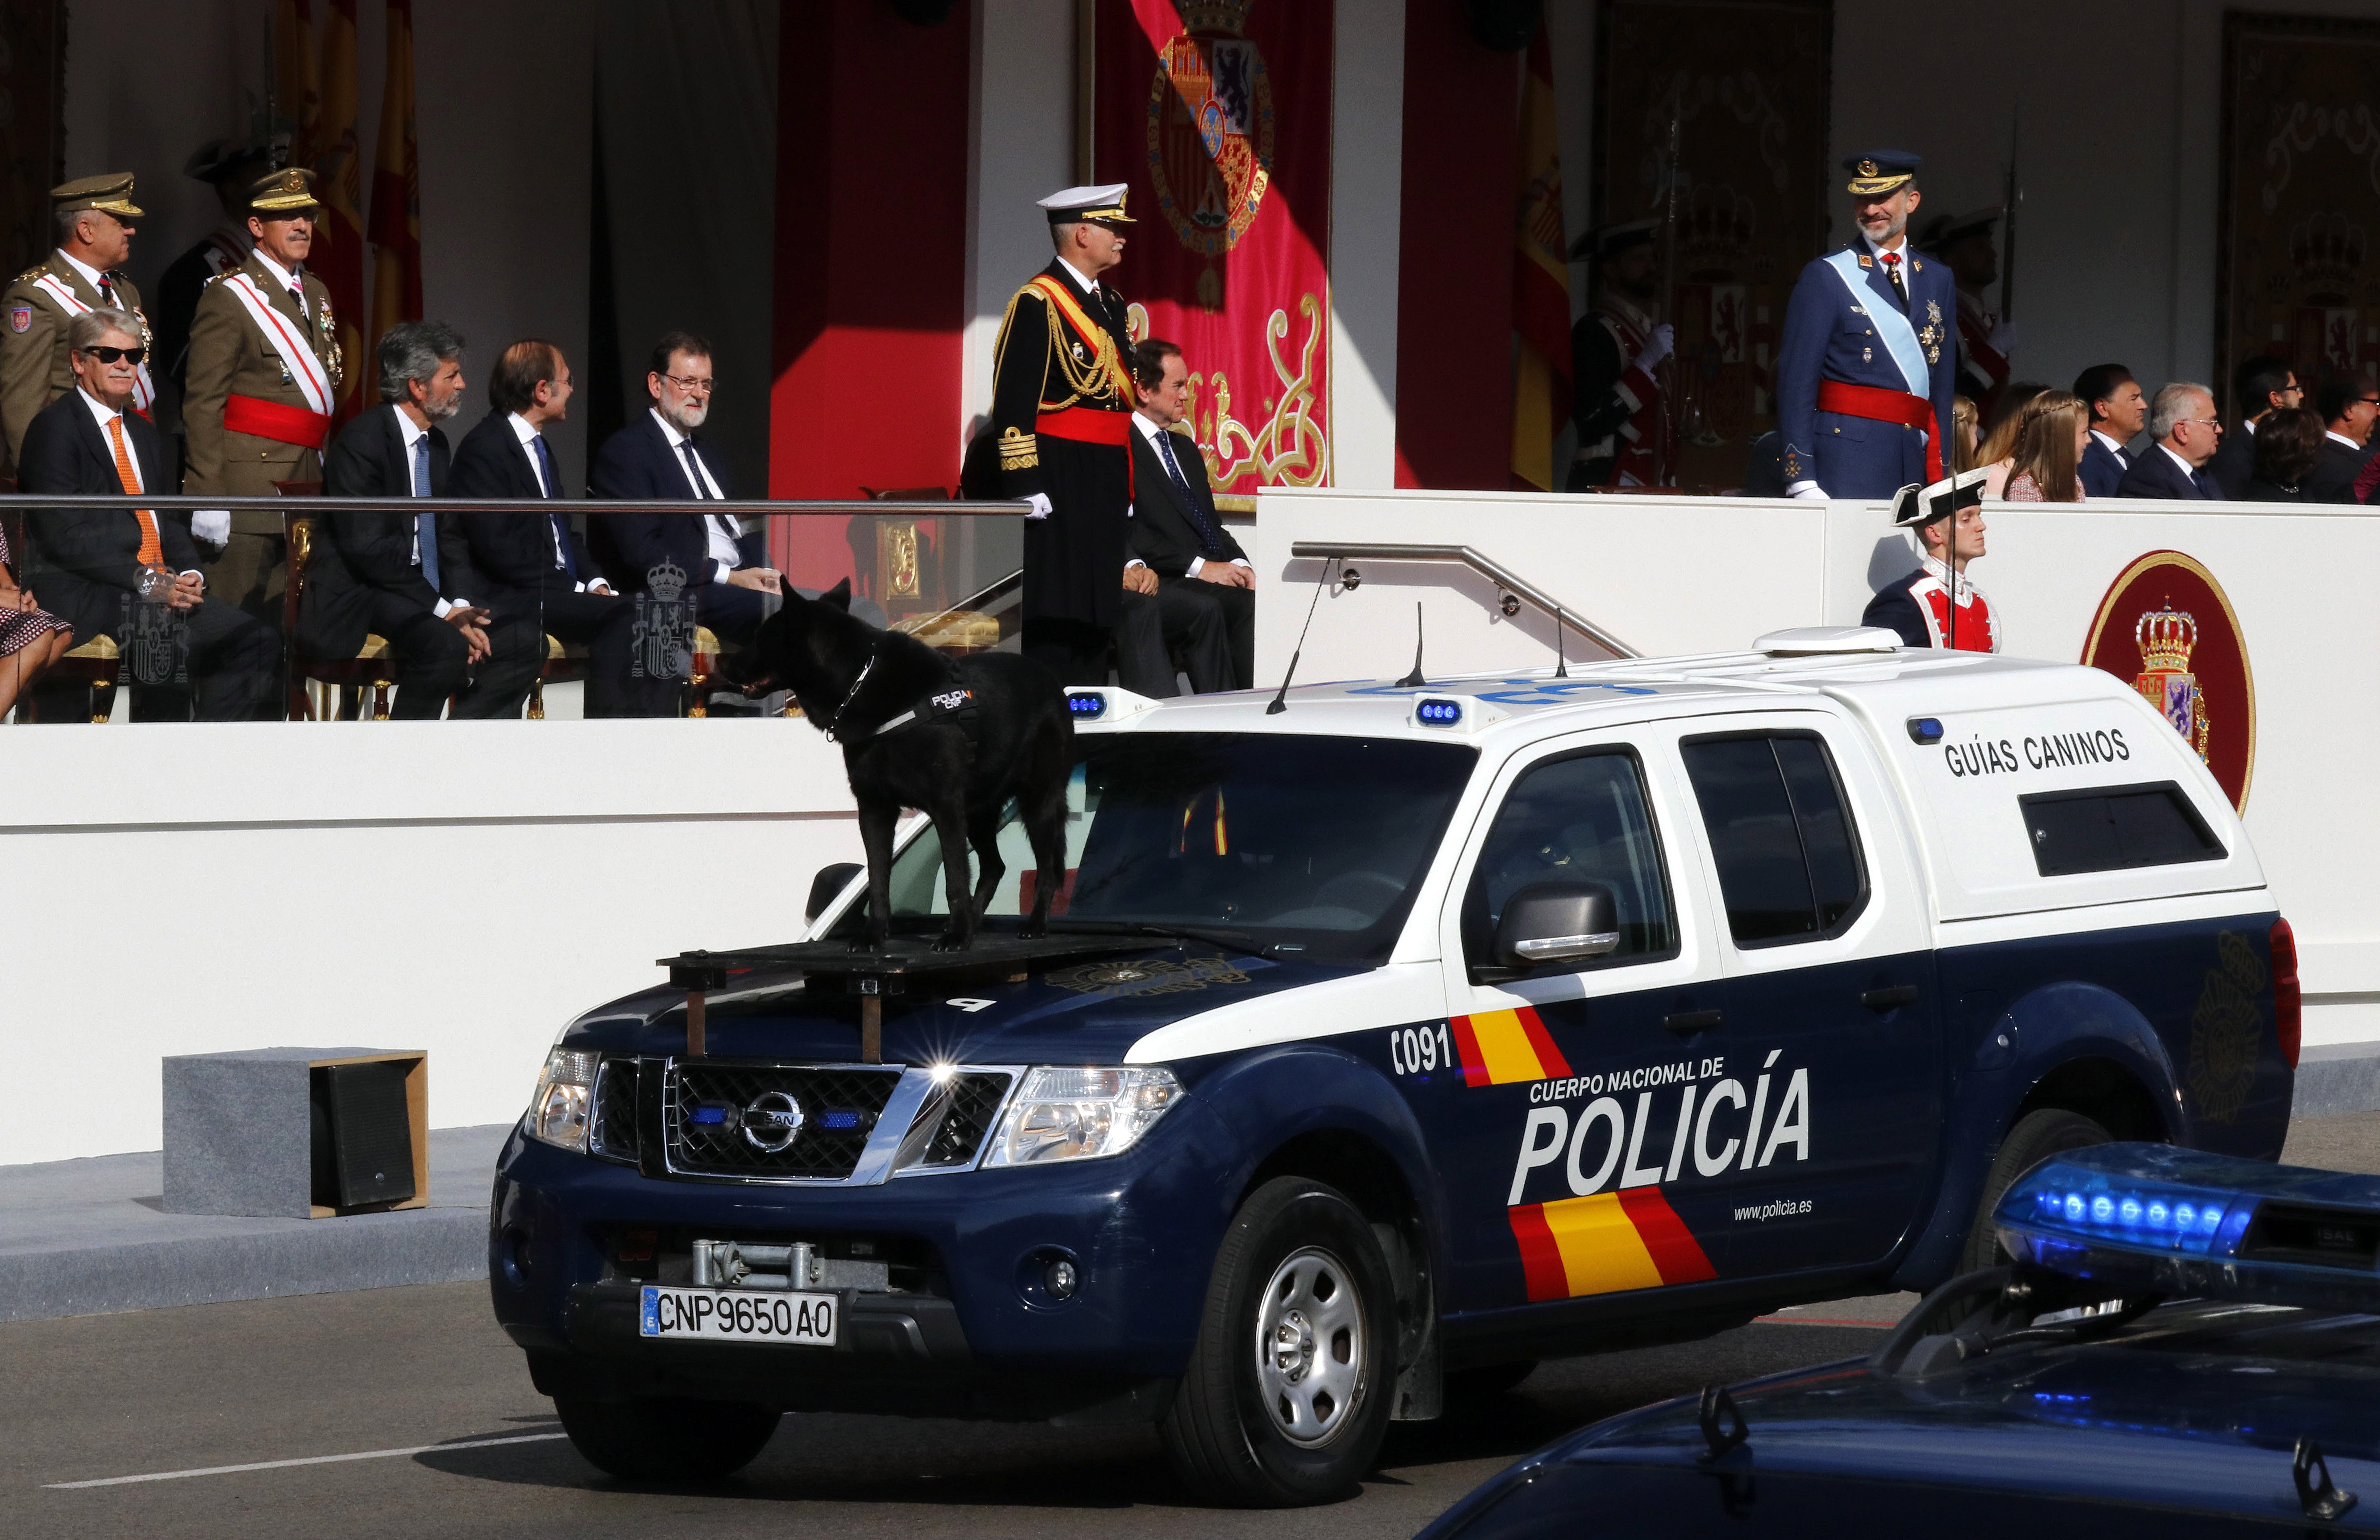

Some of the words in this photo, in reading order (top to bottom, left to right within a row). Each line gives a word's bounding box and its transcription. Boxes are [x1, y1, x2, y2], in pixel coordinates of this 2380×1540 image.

[945, 699, 962, 709] CNP
[1945, 734, 2019, 777] GUÍAS
[2024, 729, 2130, 769] CANINOS
[1403, 1023, 1451, 1073] 091
[1530, 1074, 1603, 1103] CUERPO
[1607, 1061, 1696, 1092] NACIONAL
[1700, 1057, 1724, 1078] DE
[1507, 1049, 1809, 1206] POLICÍA
[1734, 1199, 1812, 1222] www.policia.es
[647, 1317, 654, 1327] E
